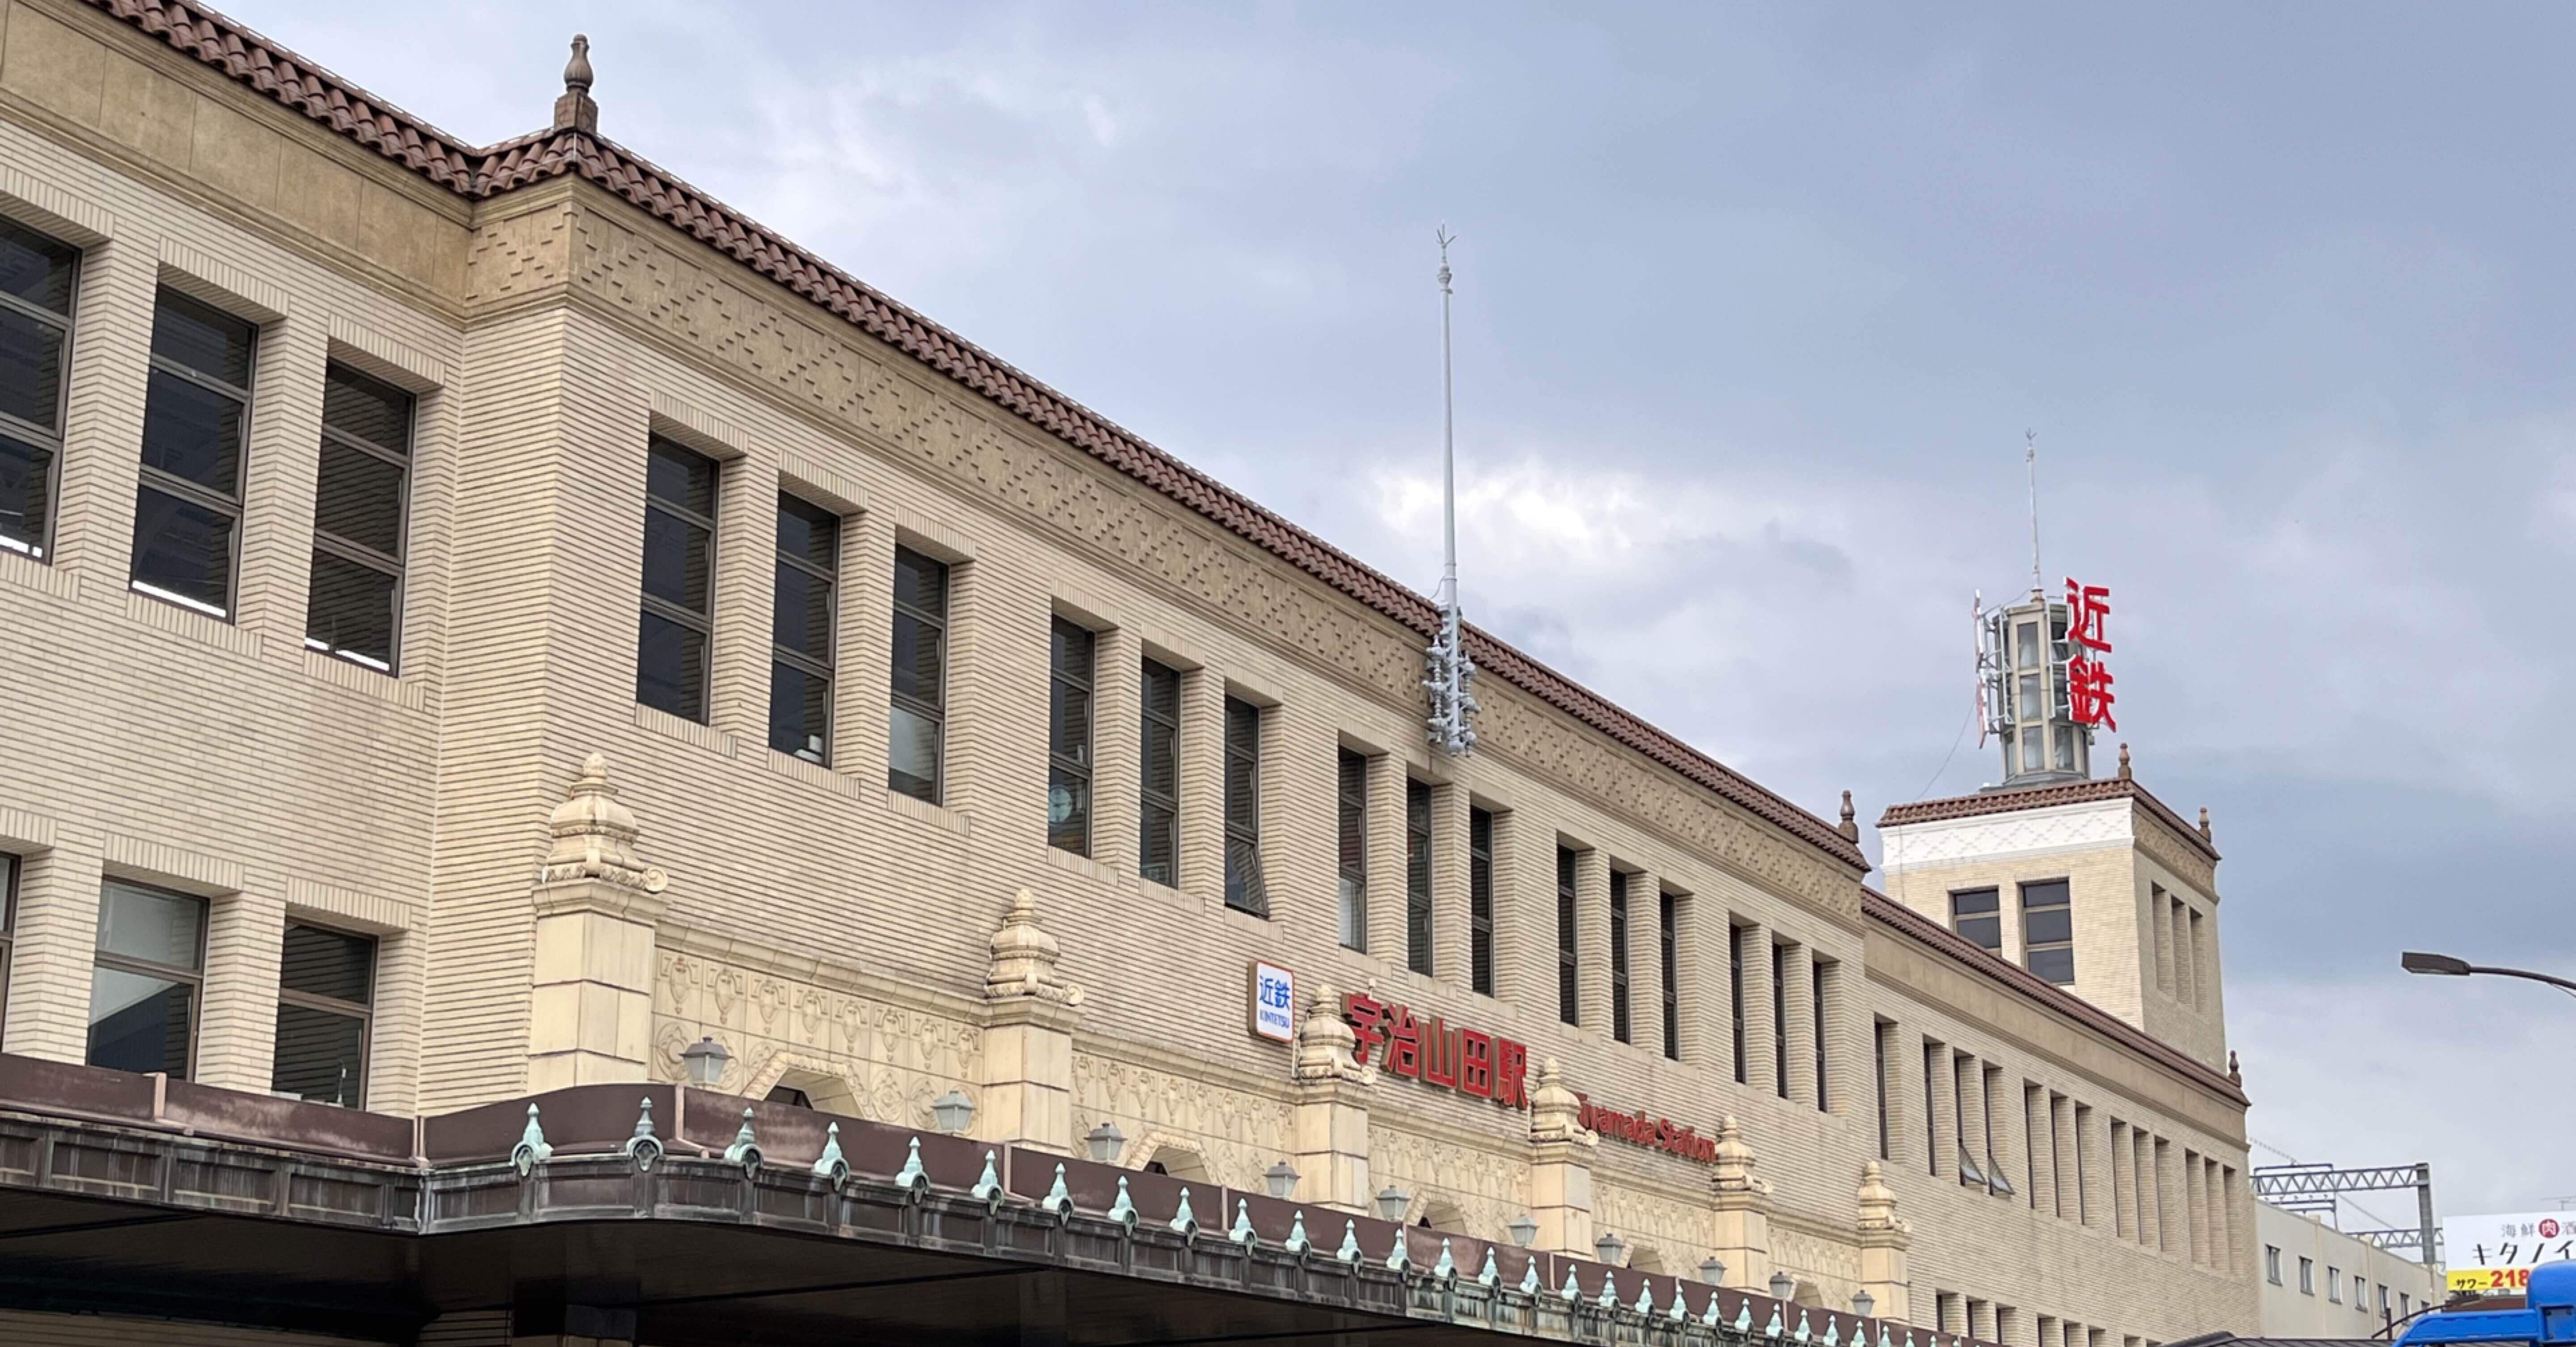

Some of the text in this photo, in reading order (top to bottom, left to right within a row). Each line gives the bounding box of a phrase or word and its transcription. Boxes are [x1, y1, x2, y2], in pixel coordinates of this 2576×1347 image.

[2064, 577, 2116, 733] 近鉄
[1259, 974, 1290, 1011] 近鉄
[1259, 1009, 1290, 1029] KINTETSU
[1344, 994, 1528, 1110] 宇治山田駅
[1660, 1118, 1716, 1163] Station
[2472, 1240, 2574, 1266] キタノイ
